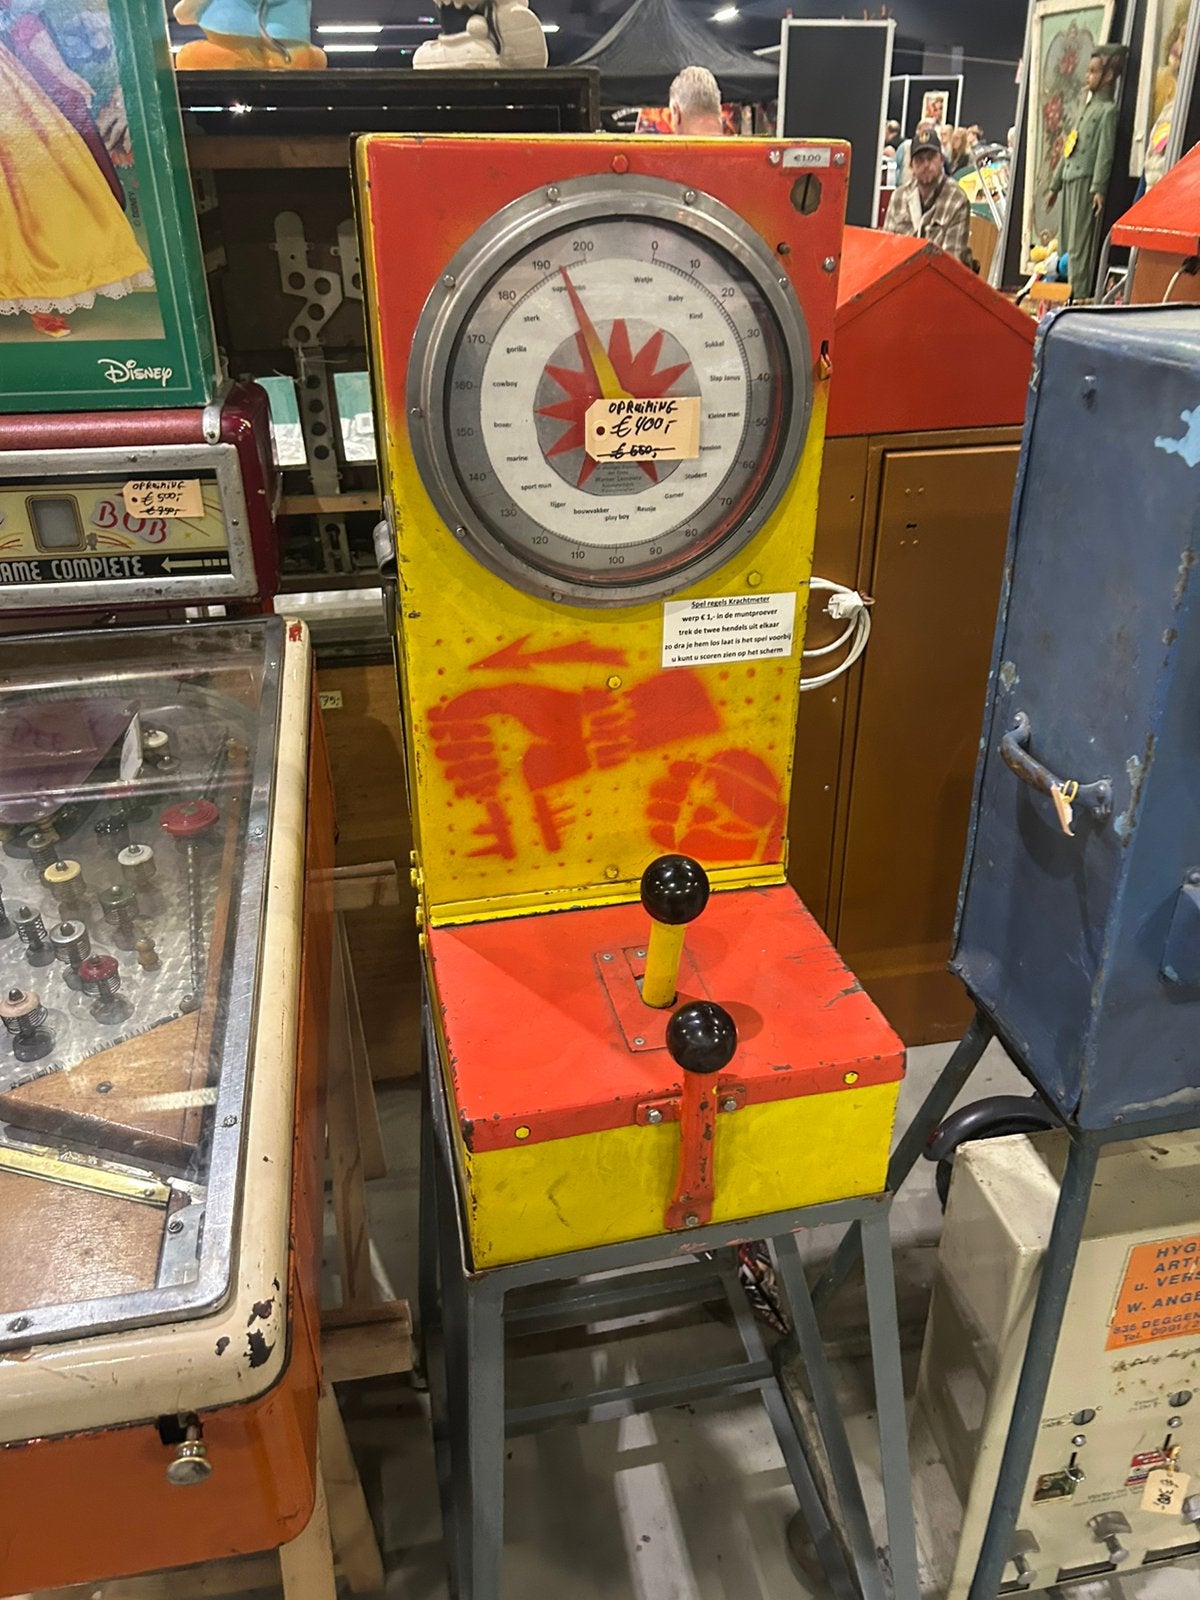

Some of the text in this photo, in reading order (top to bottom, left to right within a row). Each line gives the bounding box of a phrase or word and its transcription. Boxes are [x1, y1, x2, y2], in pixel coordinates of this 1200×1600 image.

[573, 241, 594, 251] 200
[651, 241, 659, 250] 0
[532, 260, 551, 270] 190
[690, 259, 701, 269] 10
[498, 290, 516, 300] 180
[721, 288, 735, 297] 20
[668, 295, 684, 303] Baby
[747, 328, 760, 338] 30
[467, 334, 486, 344] 170
[506, 346, 527, 354] gorilla
[757, 373, 770, 382] 40
[742, 461, 755, 469] 60
[469, 473, 486, 482] 140
[720, 497, 732, 506] 70
[500, 508, 517, 517] 130
[574, 507, 609, 515] bouwvakker
[685, 528, 698, 537] 80
[532, 536, 549, 545] 120
[571, 551, 585, 559] 110
[649, 547, 663, 555] 90
[608, 555, 625, 564] 100
[0, 555, 145, 582] AME COMPLETE
[691, 596, 770, 609] Spel regels Krachtmeter
[682, 615, 700, 623] werp
[725, 611, 733, 619] de
[734, 609, 778, 618] muntproever
[679, 628, 692, 636] trek
[721, 623, 748, 632] hendels
[759, 621, 780, 629] elkaar
[673, 641, 685, 649] dra
[685, 641, 693, 650] je
[694, 640, 709, 648] hem
[710, 638, 720, 646] los
[721, 637, 734, 645] laat
[741, 635, 753, 643] het
[754, 634, 768, 643] spel
[769, 633, 792, 641] voorbij
[677, 654, 693, 662] kunt
[700, 652, 722, 660] scoren
[723, 650, 736, 658] zien
[737, 650, 747, 658] op
[747, 648, 759, 656] het
[759, 646, 784, 655] scherm
[1156, 1242, 1200, 1258] HYG
